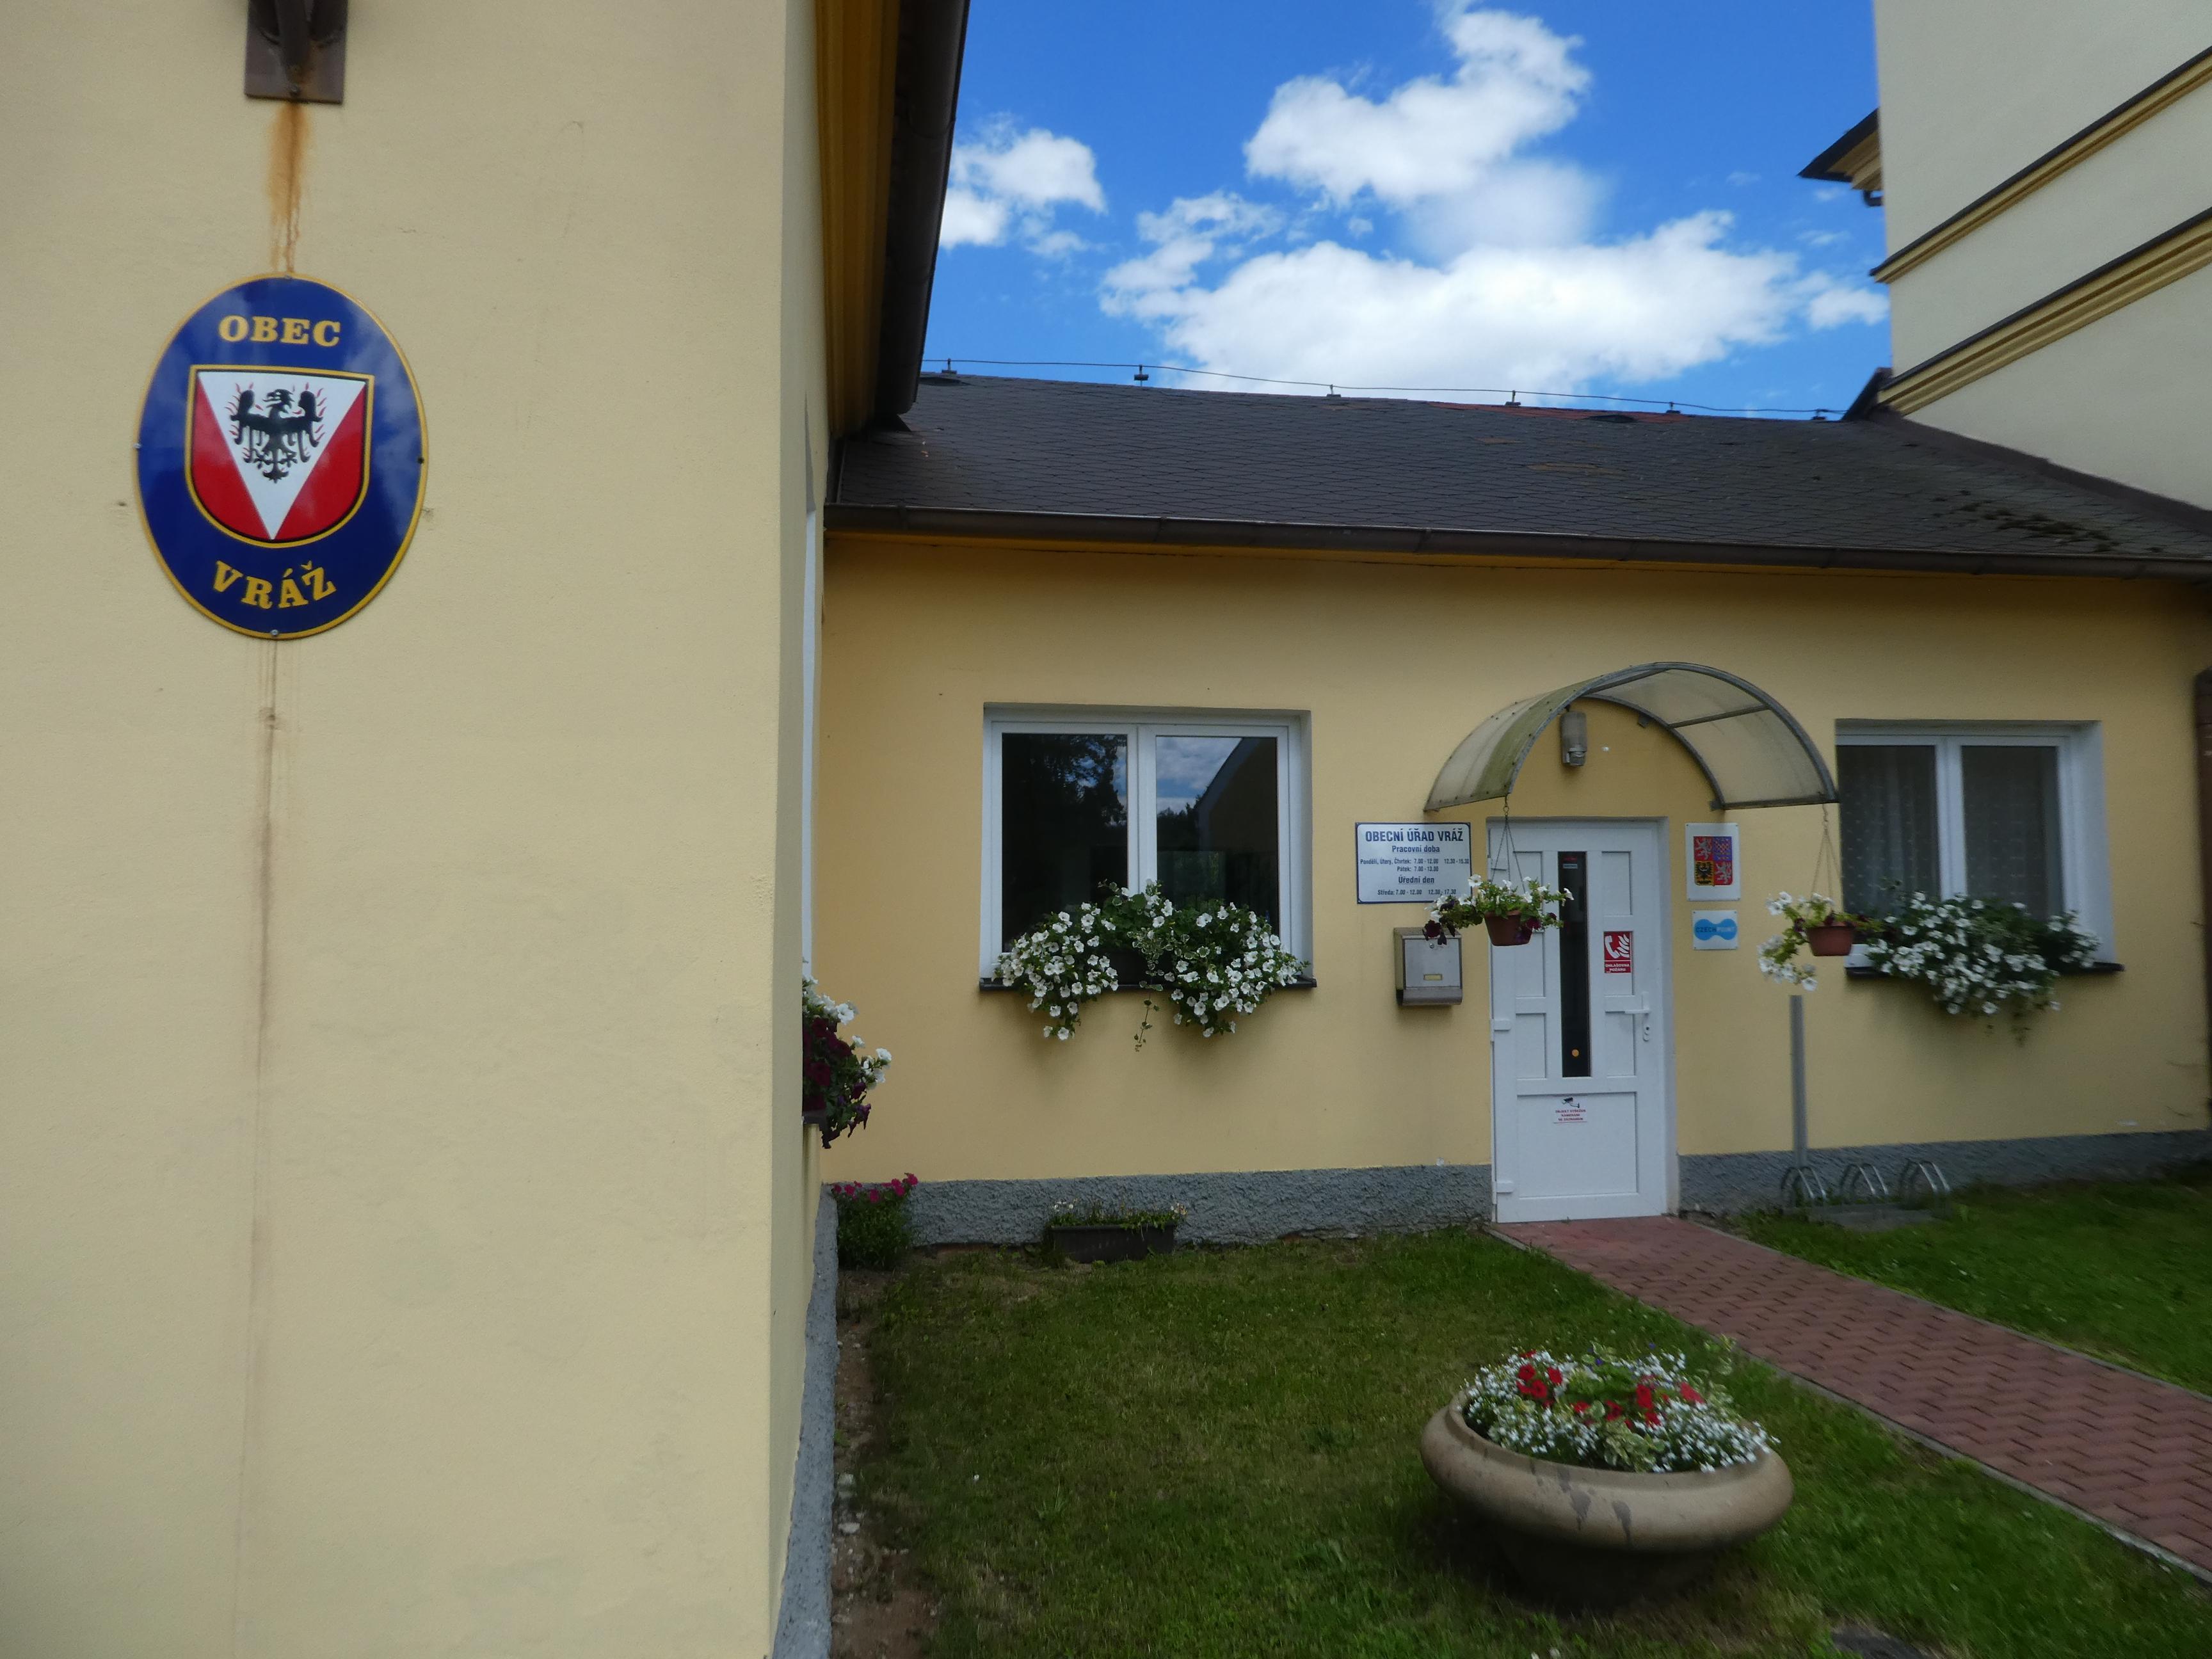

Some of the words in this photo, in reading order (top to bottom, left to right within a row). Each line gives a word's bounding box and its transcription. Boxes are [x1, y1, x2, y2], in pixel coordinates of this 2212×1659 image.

[218, 316, 341, 347] OBEC
[212, 560, 337, 609] VRÁŽ
[1365, 828, 1404, 842] OBECNÍ
[1407, 828, 1434, 842] ÚŘAD
[1438, 828, 1463, 842] VRÁŽ
